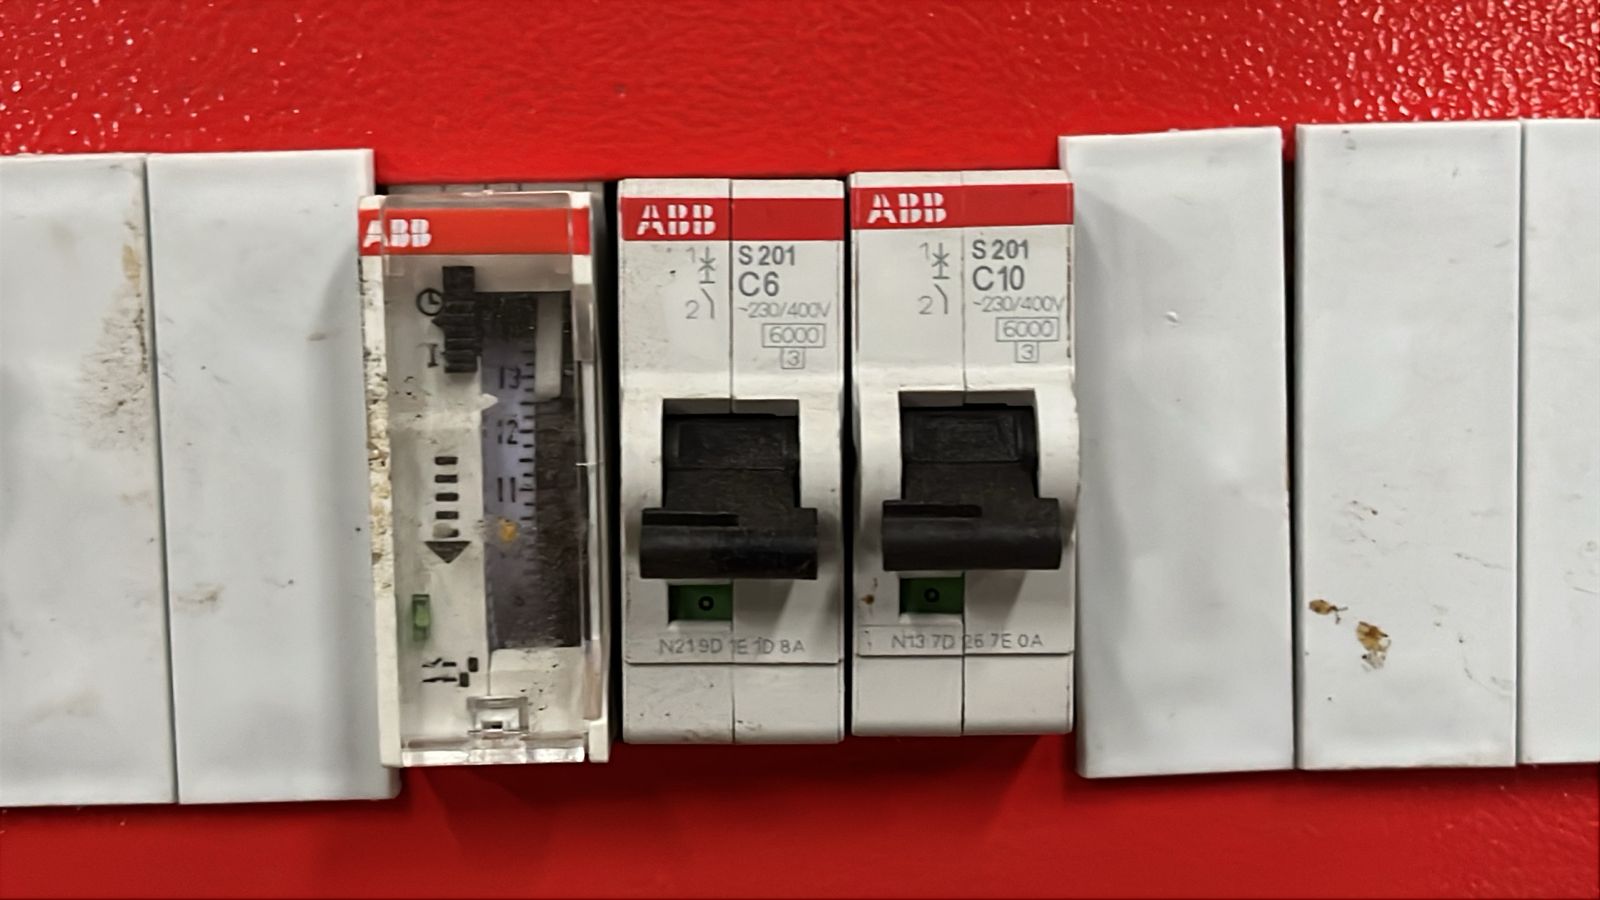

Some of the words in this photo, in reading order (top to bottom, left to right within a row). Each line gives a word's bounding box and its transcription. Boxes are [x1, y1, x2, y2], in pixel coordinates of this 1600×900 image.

[867, 192, 947, 224] ABB
[637, 204, 717, 236] ABB
[362, 218, 433, 249] ABB
[738, 245, 753, 266] S
[758, 245, 797, 266] 201
[972, 239, 986, 260] S
[991, 239, 1029, 260] 201
[738, 271, 780, 297] C6
[972, 265, 1025, 291] C10
[769, 326, 820, 344] 6000
[1002, 320, 1054, 338] 6000
[787, 350, 800, 366] 3
[1021, 343, 1034, 360] 3
